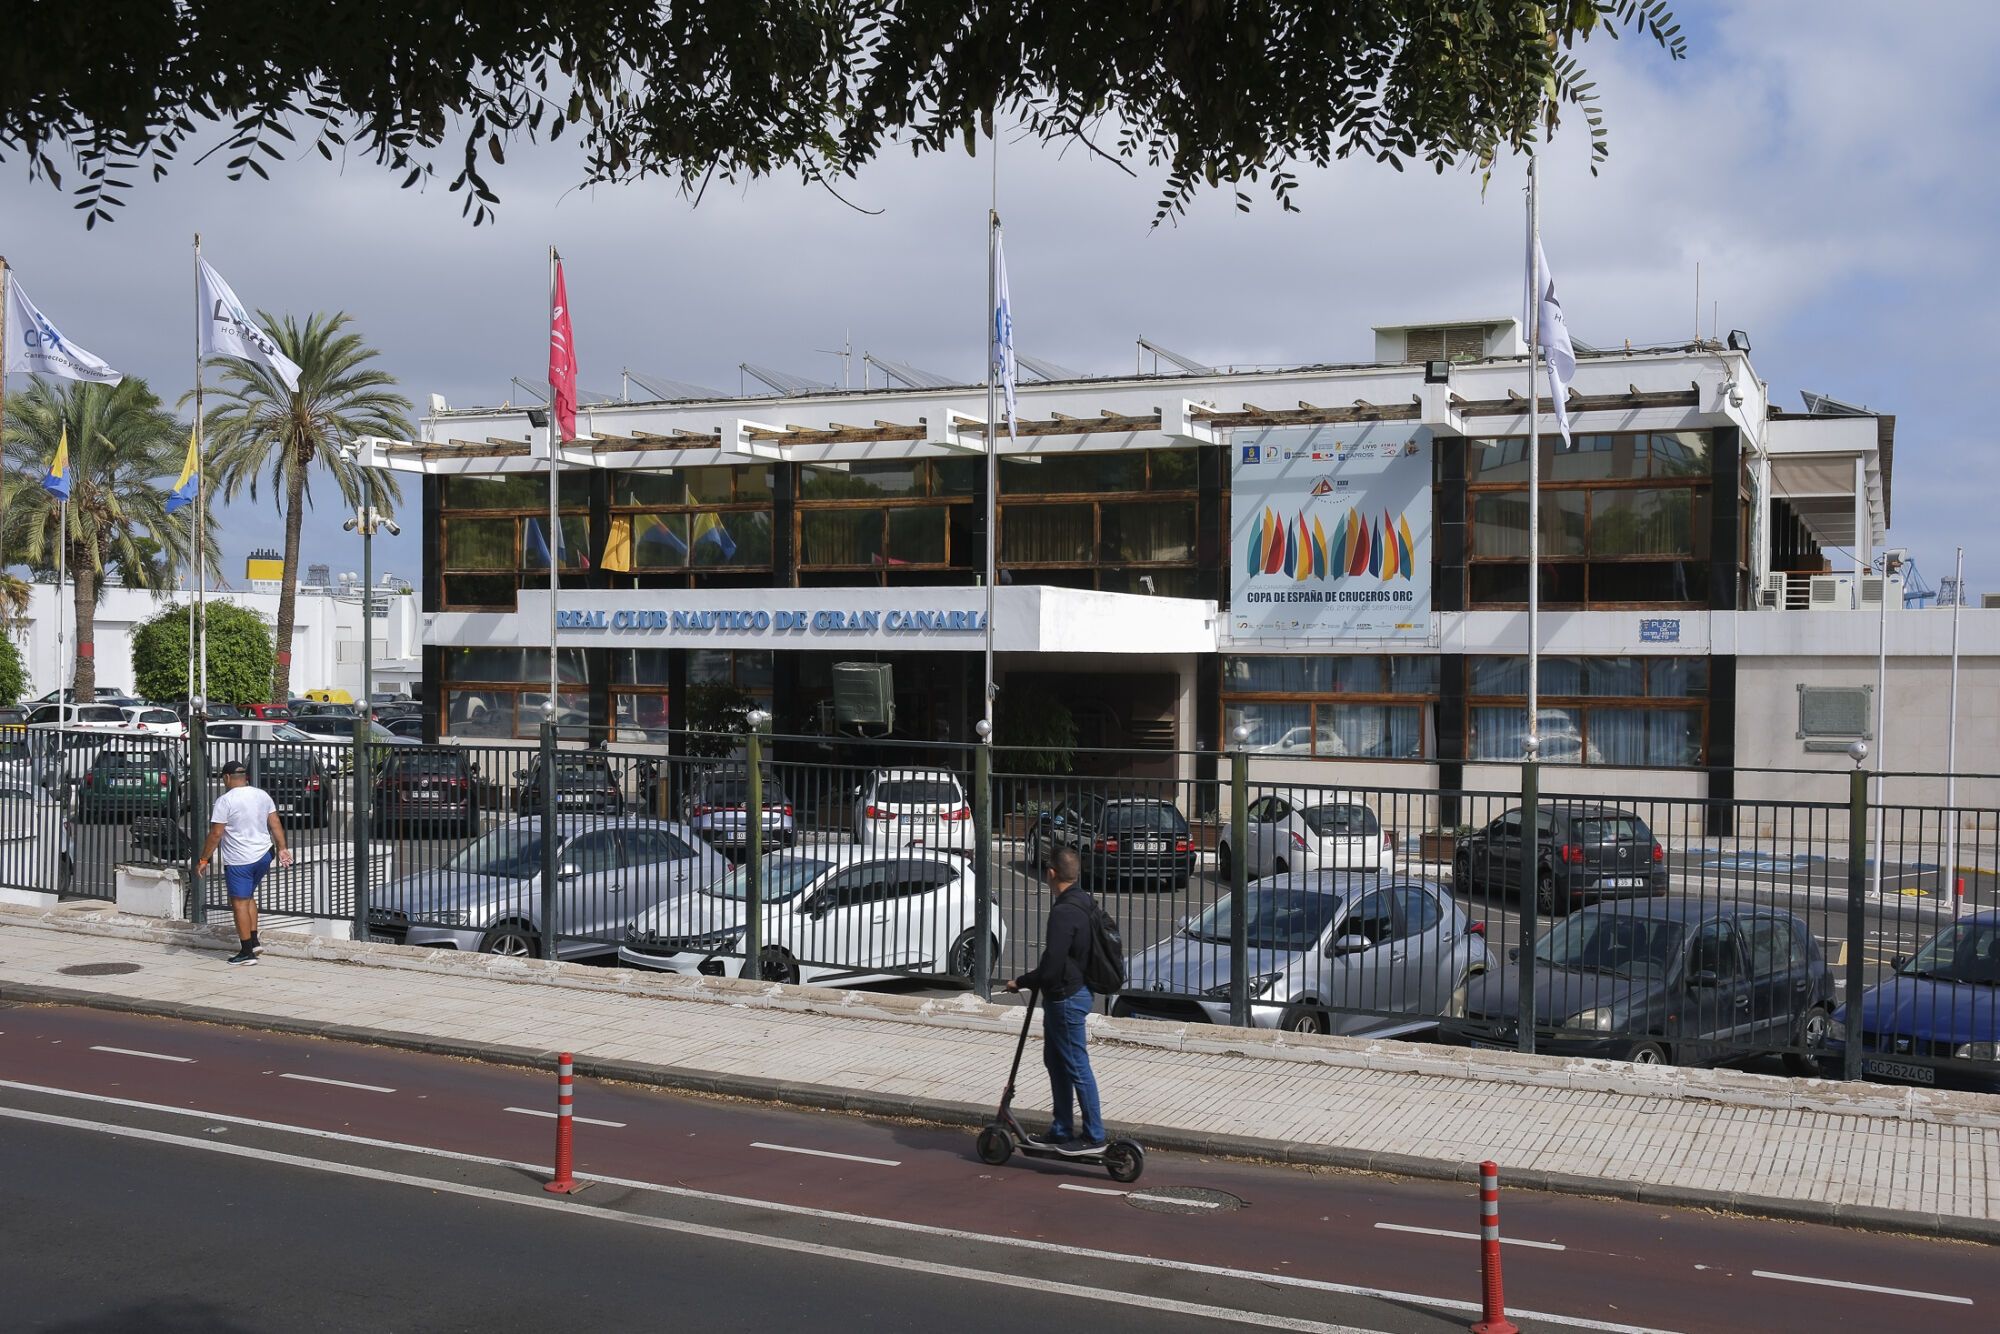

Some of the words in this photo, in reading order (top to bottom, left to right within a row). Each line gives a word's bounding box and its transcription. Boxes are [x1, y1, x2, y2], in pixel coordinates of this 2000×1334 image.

[1247, 592, 1272, 603] COPA
[1274, 592, 1286, 602] DE
[1287, 589, 1323, 603] ESPAÑA
[1325, 592, 1337, 602] DE
[1339, 591, 1391, 602] CRUCEROS
[1393, 590, 1413, 602] ORC
[557, 610, 608, 629] REAL
[613, 610, 668, 629] CLUB
[673, 610, 770, 630] NAUTICO
[776, 610, 807, 630] DE
[813, 610, 880, 630] GRAN
[887, 610, 988, 630] CANARIA
[1869, 1060, 1934, 1082] GC2624CG
